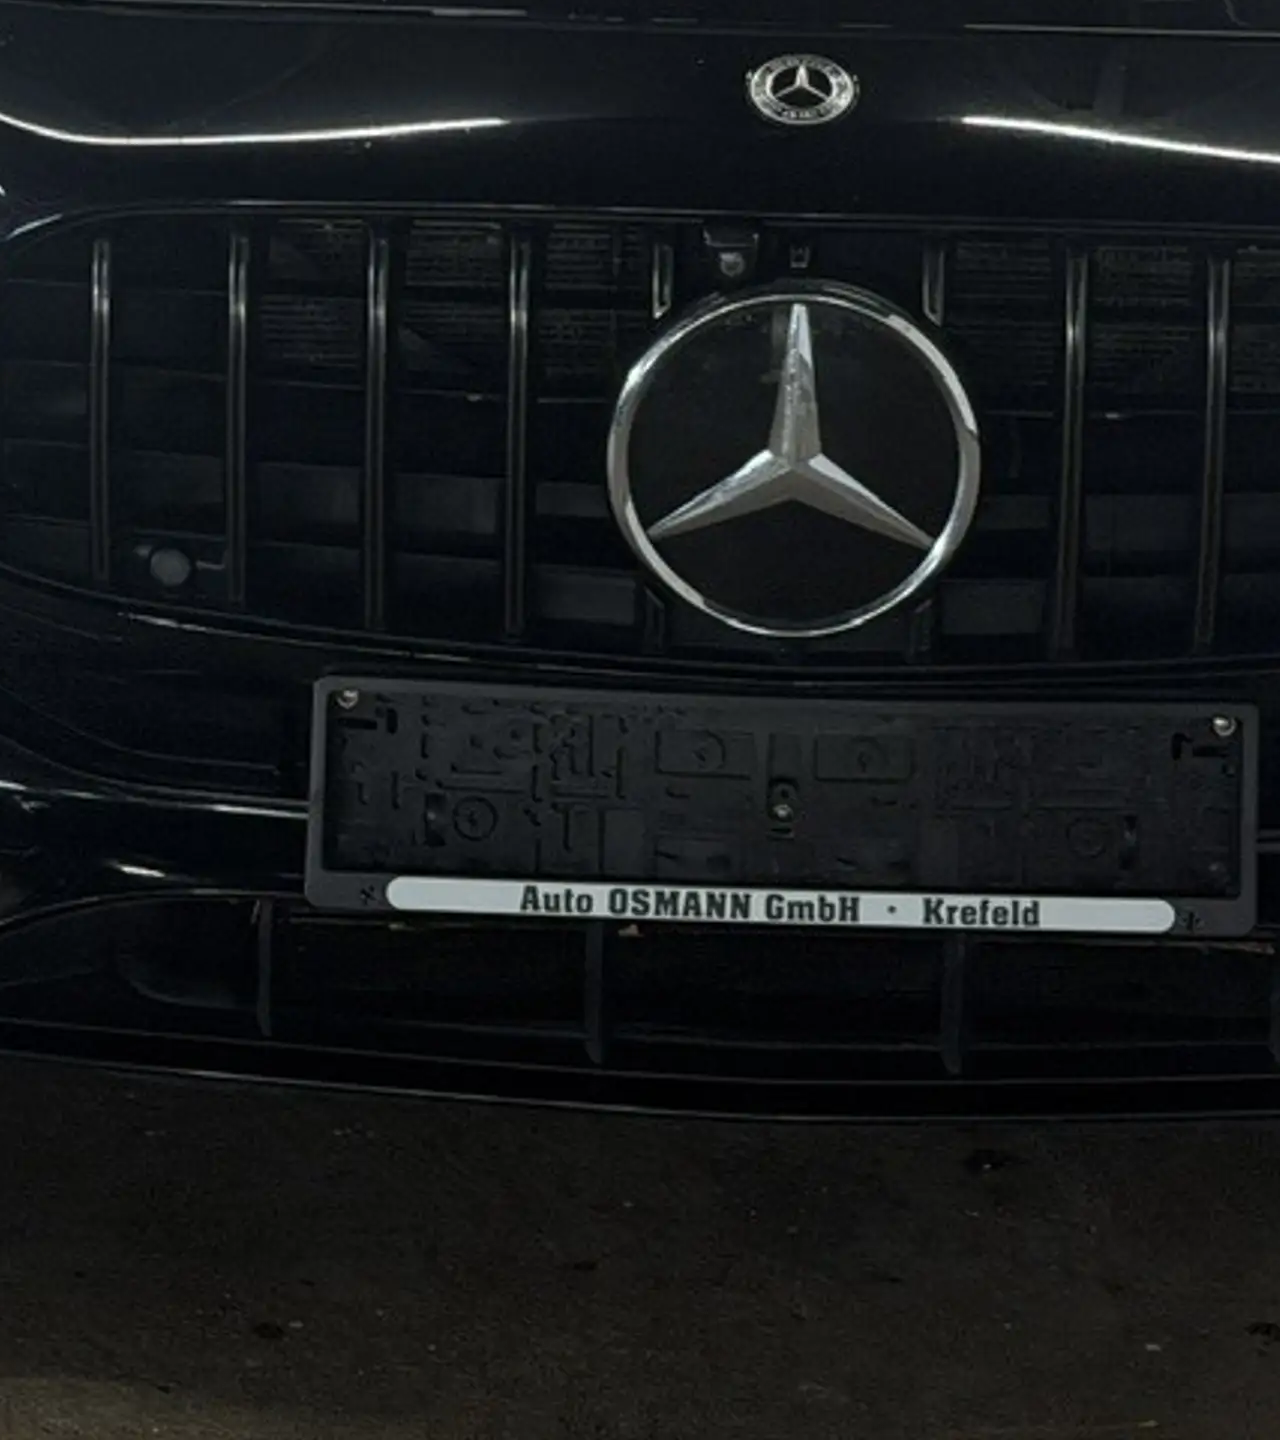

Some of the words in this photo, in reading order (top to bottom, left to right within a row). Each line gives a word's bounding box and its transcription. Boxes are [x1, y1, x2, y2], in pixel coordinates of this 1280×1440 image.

[521, 885, 594, 913] Auto
[609, 888, 751, 919] OSMANN
[765, 893, 860, 922] GmbH
[923, 897, 1040, 926] Krefeld
